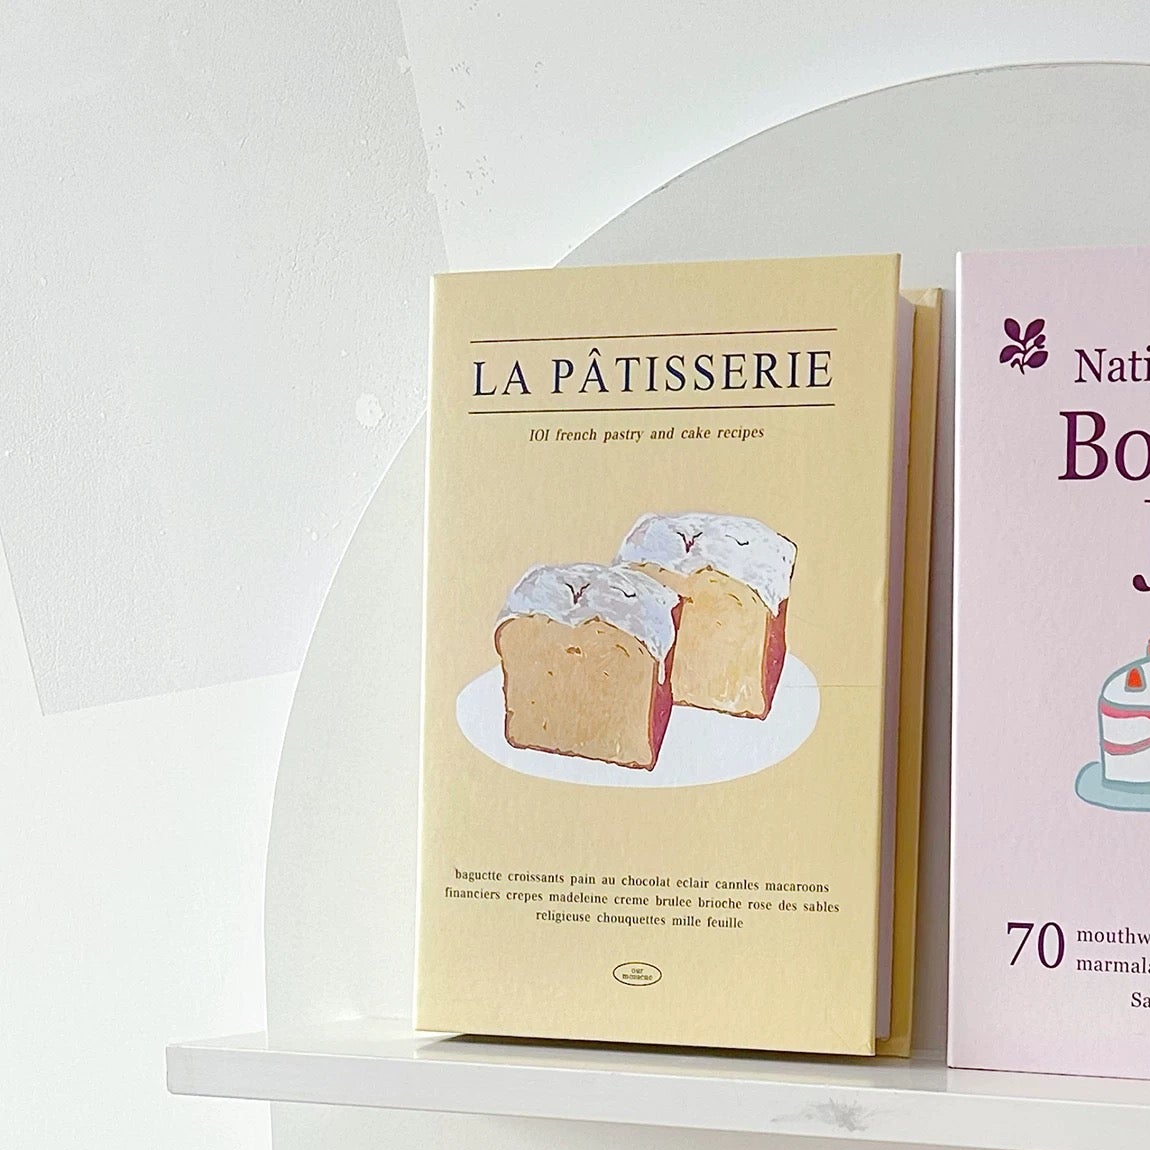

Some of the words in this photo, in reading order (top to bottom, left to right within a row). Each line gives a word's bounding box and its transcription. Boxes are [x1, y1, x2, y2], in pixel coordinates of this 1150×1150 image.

[472, 360, 531, 396] LA
[551, 347, 833, 395] PÂTISSERIE
[556, 428, 597, 441] french
[604, 430, 644, 443] pastry
[650, 428, 674, 439] and
[681, 428, 711, 439] cake
[717, 426, 764, 441] recipes
[455, 869, 502, 882] baguette
[508, 871, 564, 883] croissants
[570, 874, 596, 886] pain
[602, 876, 615, 885] au
[621, 874, 670, 888] chocolat
[676, 877, 709, 889] eclair
[715, 880, 759, 890] cannles
[765, 882, 829, 893] macaroons
[445, 887, 501, 900] financiers
[506, 892, 543, 903] crepes
[549, 892, 608, 904] madeleine
[614, 896, 649, 906] creme
[656, 896, 692, 907] brulee
[698, 897, 742, 909] brioche
[748, 900, 772, 911] rose
[779, 899, 797, 911] des
[803, 901, 839, 913] sables
[536, 910, 591, 924] religieuse
[597, 911, 666, 926] chouquettes
[672, 916, 701, 927] mille
[707, 917, 743, 928] feuille
[1006, 921, 1065, 969] 70
